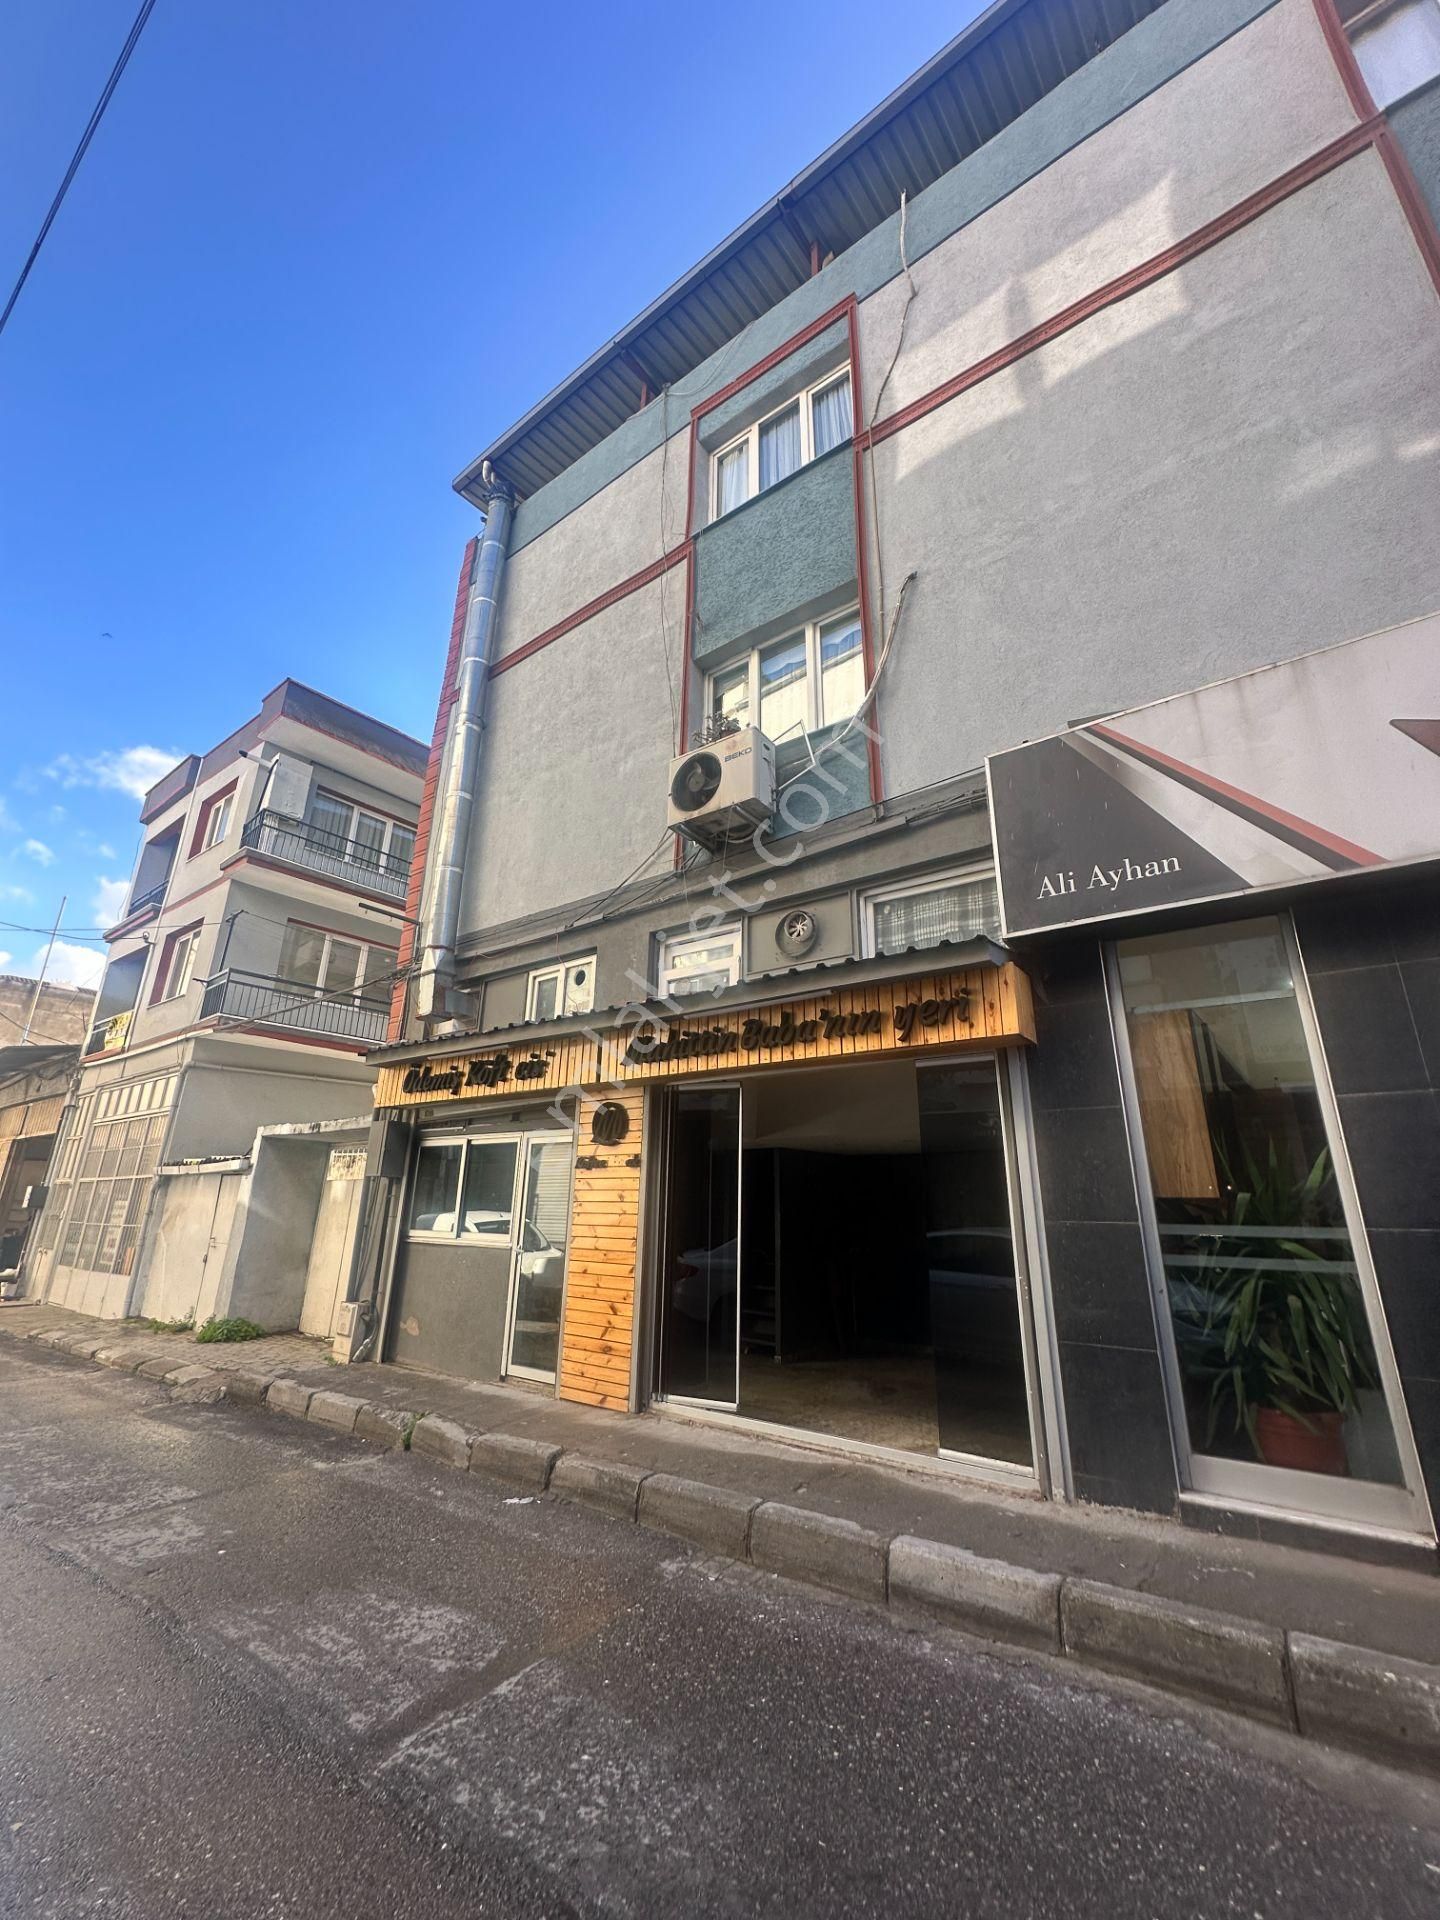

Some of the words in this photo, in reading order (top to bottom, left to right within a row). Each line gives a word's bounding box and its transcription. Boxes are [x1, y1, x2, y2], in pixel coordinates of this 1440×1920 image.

[724, 747, 752, 762] BEKO
[1036, 871, 1077, 900] Ali
[1086, 856, 1182, 891] Ayhan
[895, 987, 971, 1043] yeri
